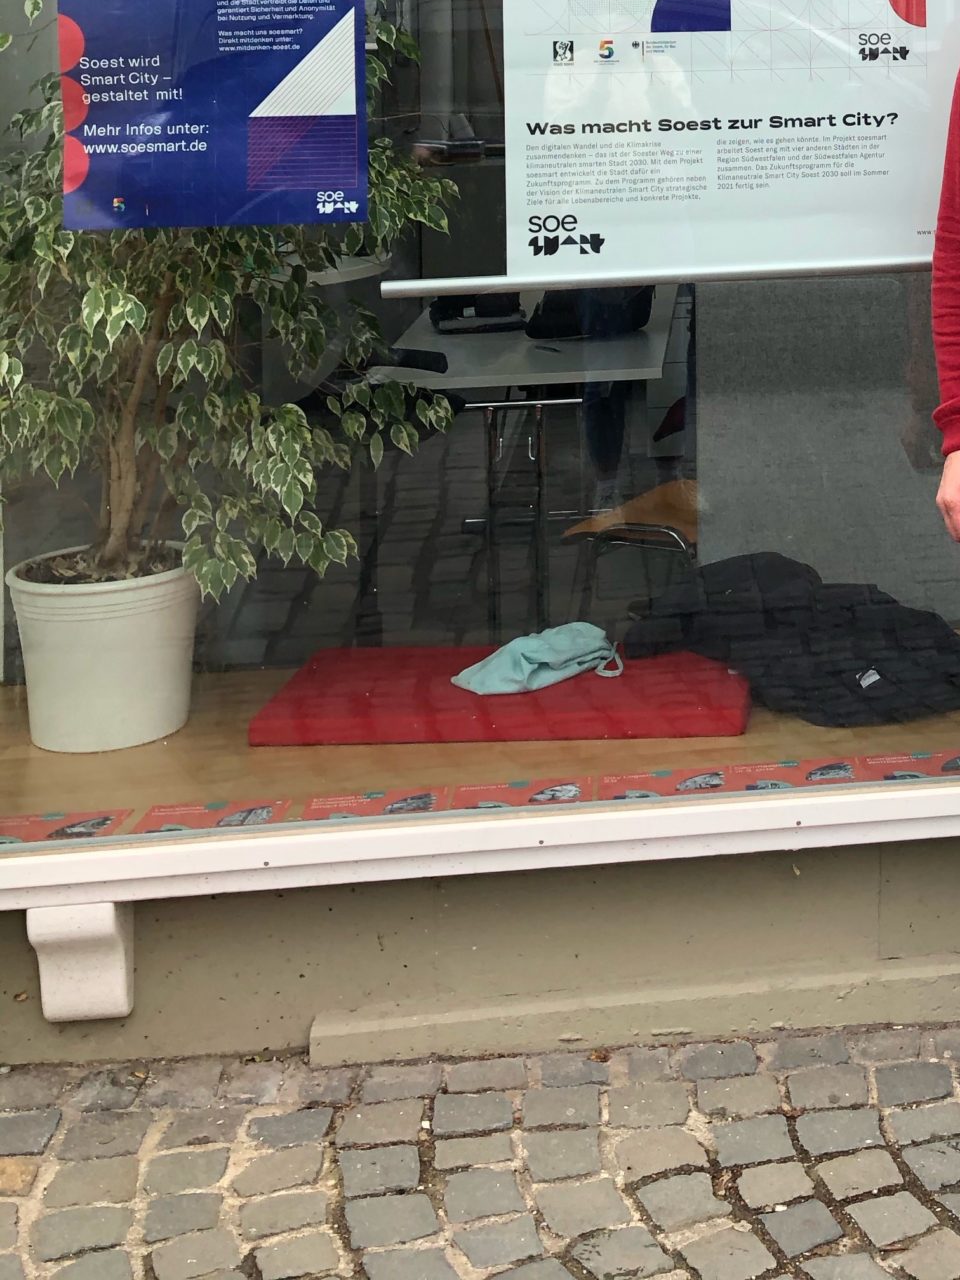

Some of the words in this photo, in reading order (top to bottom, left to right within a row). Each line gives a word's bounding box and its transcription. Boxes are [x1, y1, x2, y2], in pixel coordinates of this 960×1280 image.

[859, 33, 891, 45] soe
[599, 40, 614, 59] 5
[80, 56, 125, 69] Soest
[129, 55, 160, 67] wird
[81, 73, 125, 86] Smart
[129, 72, 159, 86] City
[82, 89, 148, 104] gestaltet
[156, 88, 183, 100] mit!
[84, 124, 121, 136] Mehr
[126, 123, 161, 135] Infos
[168, 123, 209, 135] unter:
[526, 122, 576, 135] Was
[582, 120, 652, 133] macht
[658, 117, 722, 132] Soest
[728, 117, 762, 130] zur
[769, 114, 836, 129] Smart
[843, 112, 899, 127] City?
[83, 140, 207, 154] www.soesmart.de
[317, 191, 344, 201] soe
[528, 214, 578, 234] soe
